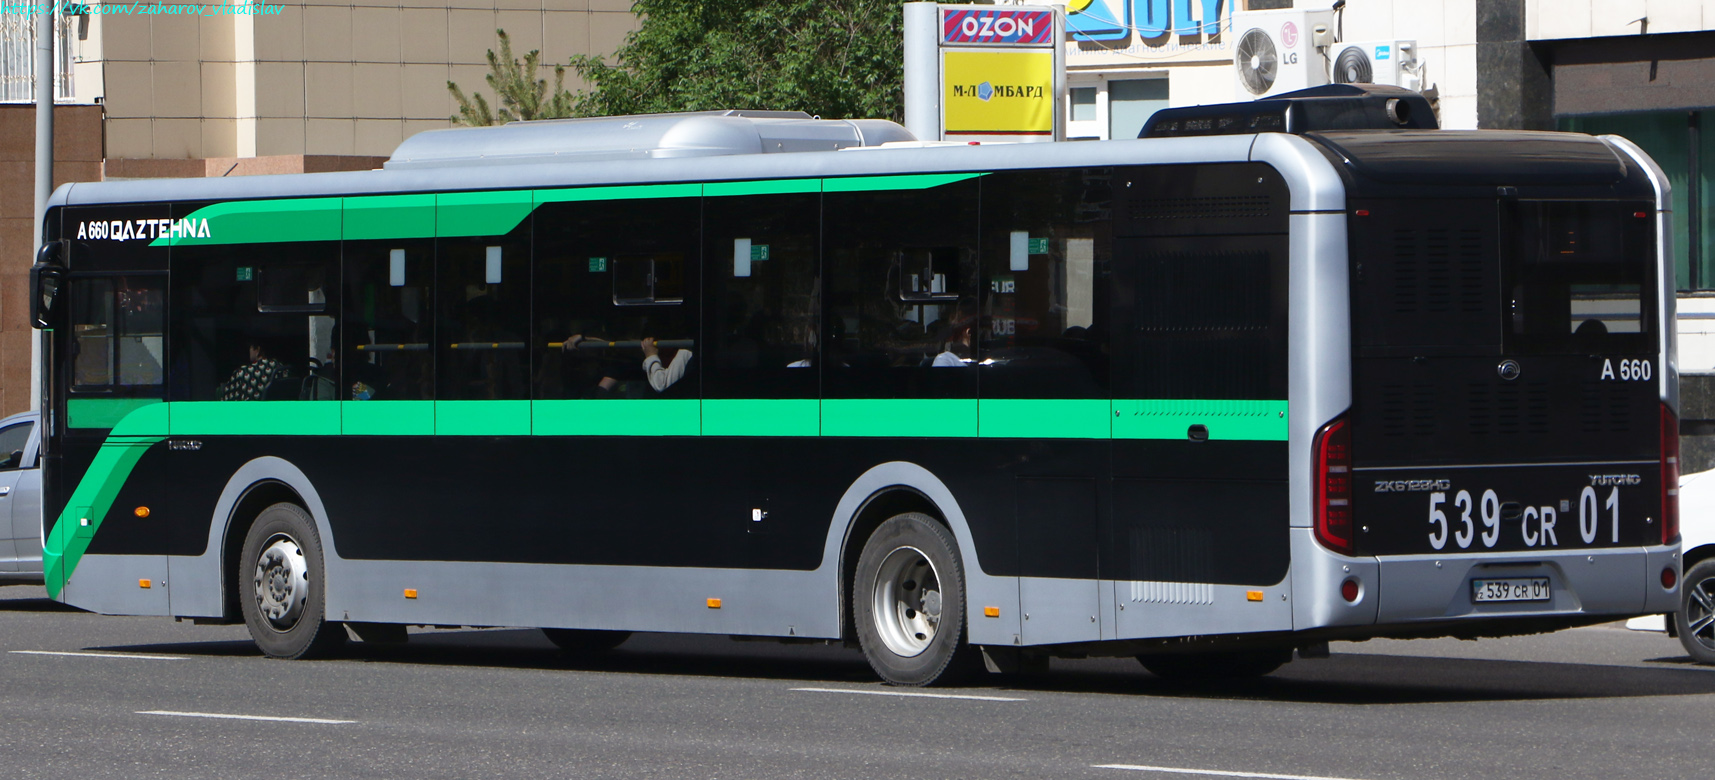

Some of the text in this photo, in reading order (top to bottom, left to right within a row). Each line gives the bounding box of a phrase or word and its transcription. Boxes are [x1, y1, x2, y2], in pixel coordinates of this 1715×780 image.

[962, 16, 1034, 37] OZON
[1283, 53, 1298, 65] LG
[77, 218, 212, 242] A 660 QAZTEHNA
[1601, 358, 1652, 381] A 660
[1588, 474, 1641, 486] YUTONG
[1428, 485, 1619, 550] 539 CR 01
[1487, 582, 1510, 599] 539
[1514, 585, 1529, 598] CR
[1533, 581, 1548, 597] 01
